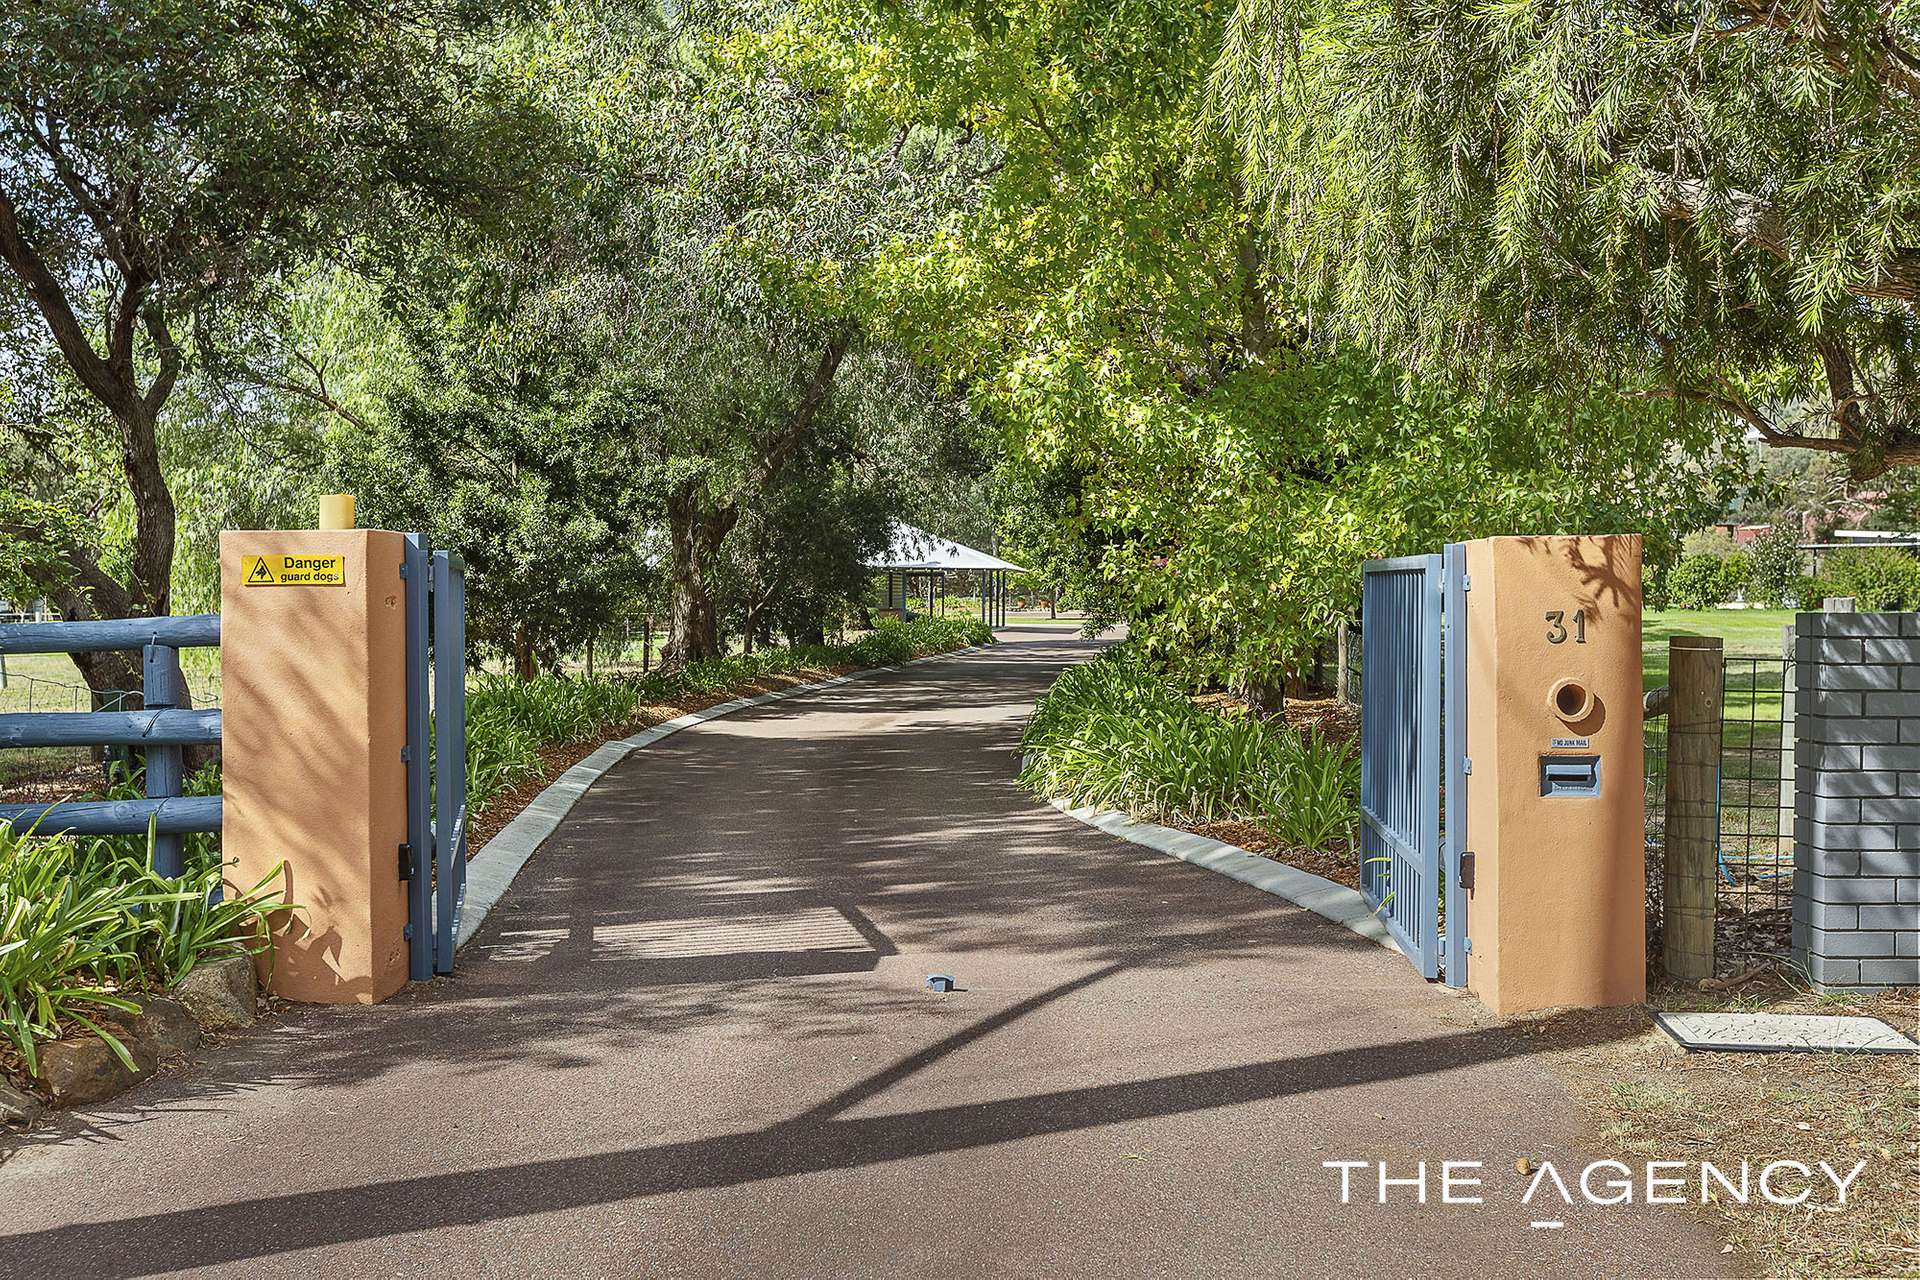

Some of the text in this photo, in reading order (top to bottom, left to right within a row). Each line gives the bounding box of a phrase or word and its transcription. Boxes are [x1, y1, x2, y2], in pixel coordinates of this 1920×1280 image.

[285, 557, 335, 570] Danger
[281, 572, 339, 582] guard dogs
[1546, 609, 1586, 644] 31
